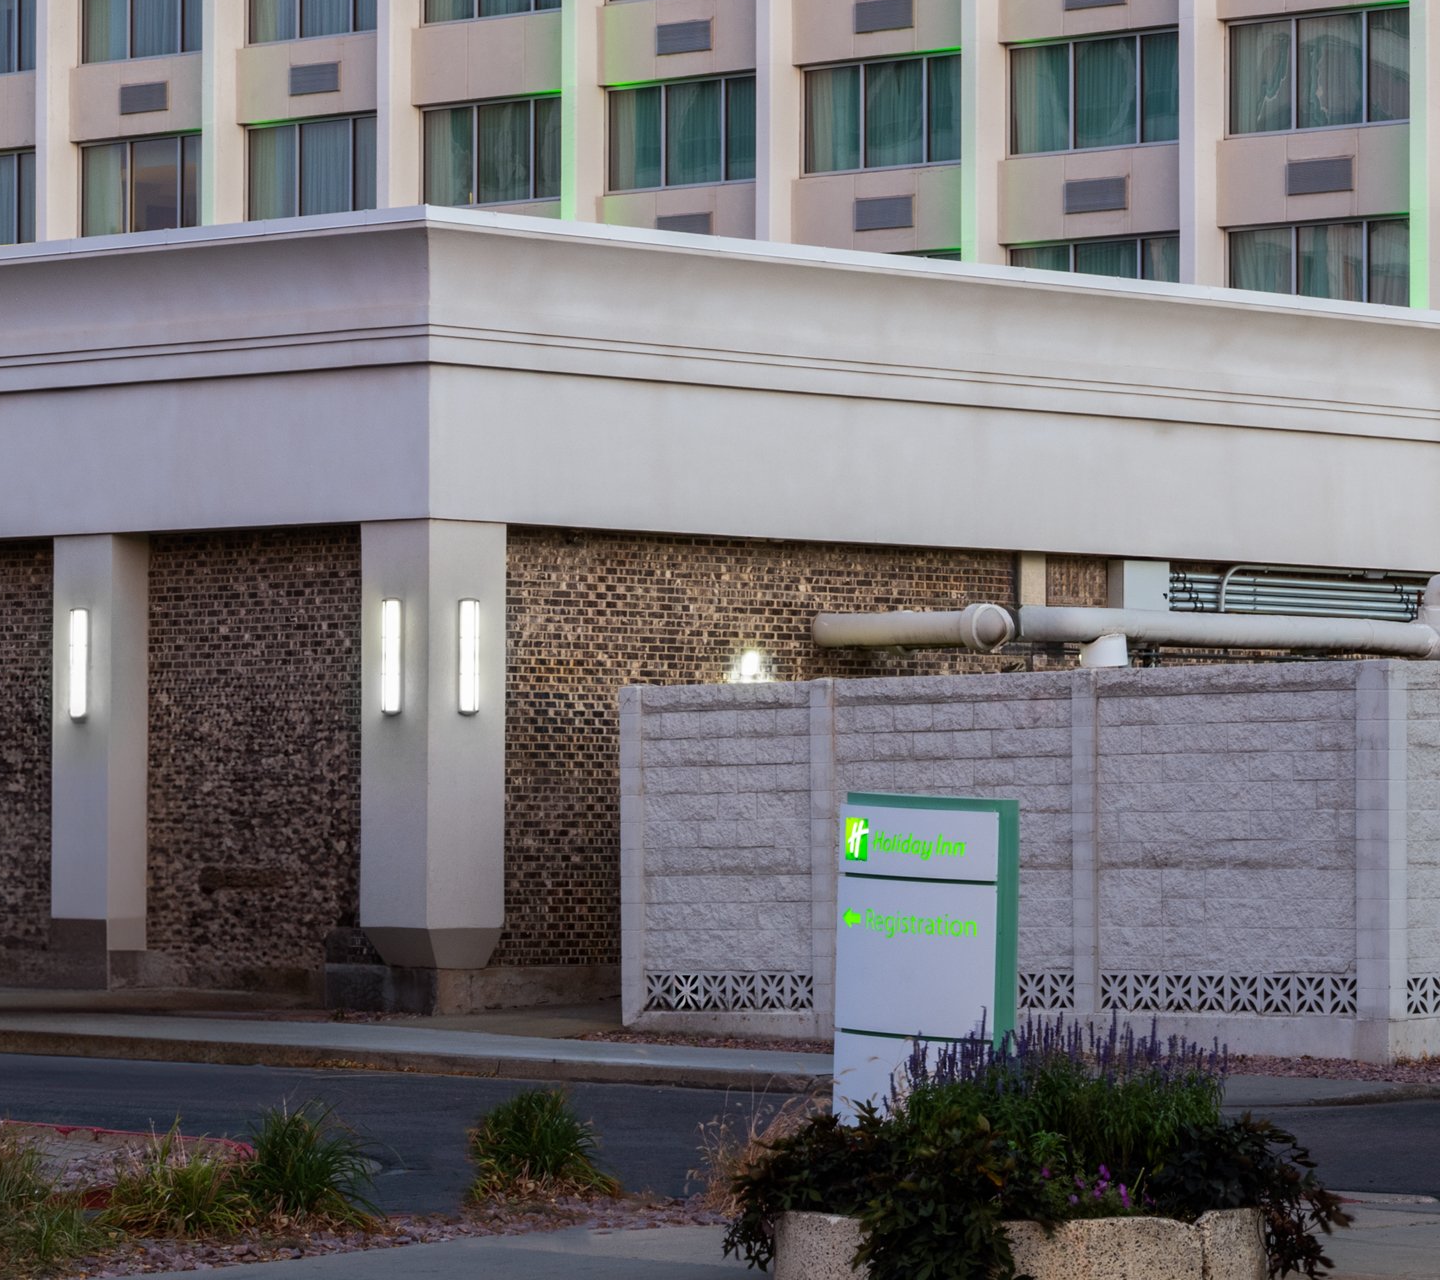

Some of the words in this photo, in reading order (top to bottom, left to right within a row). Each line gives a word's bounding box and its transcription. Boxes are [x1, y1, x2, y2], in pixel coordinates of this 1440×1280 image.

[873, 830, 933, 861] Holiday
[935, 833, 967, 857] Inn
[865, 907, 978, 939] Registration
